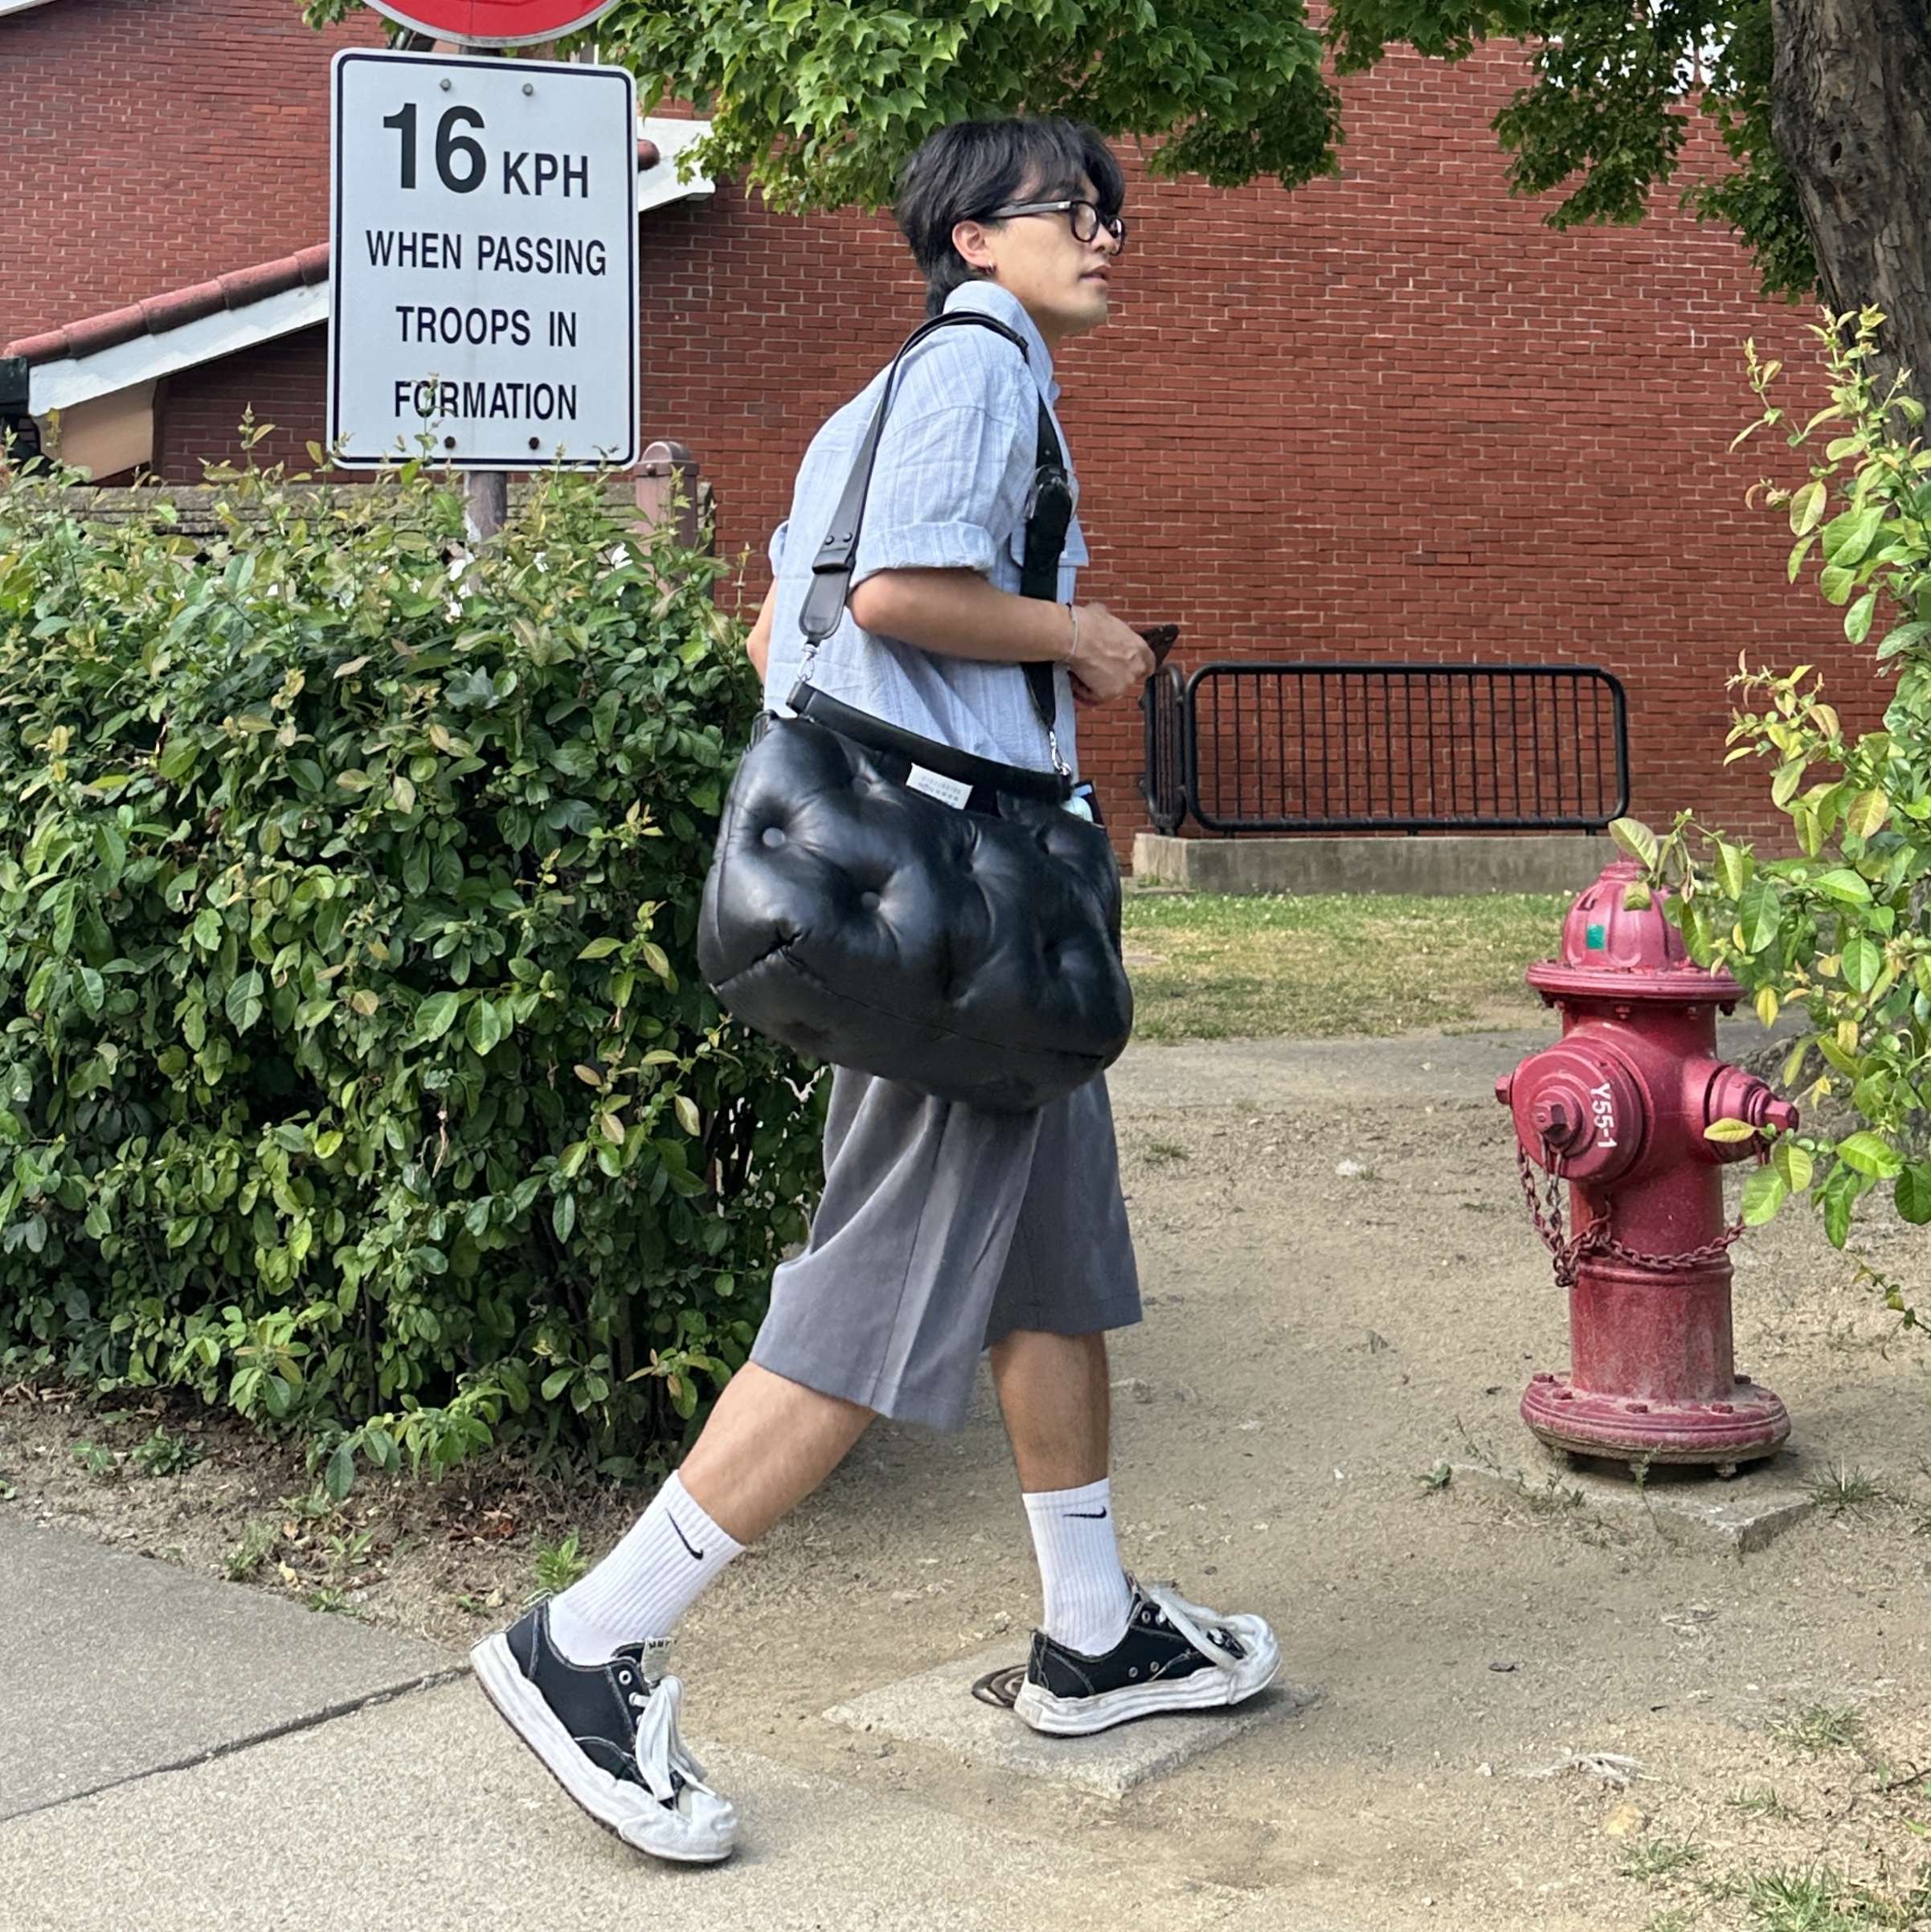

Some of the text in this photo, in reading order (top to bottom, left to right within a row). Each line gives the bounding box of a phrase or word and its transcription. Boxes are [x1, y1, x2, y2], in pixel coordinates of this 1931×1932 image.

[383, 102, 588, 199] 16 KPH
[366, 230, 606, 276] WHEN PASSING
[395, 305, 576, 347] TROOPS IN
[395, 380, 576, 420] FORMATION
[1590, 1083, 1617, 1148] Y55-1
